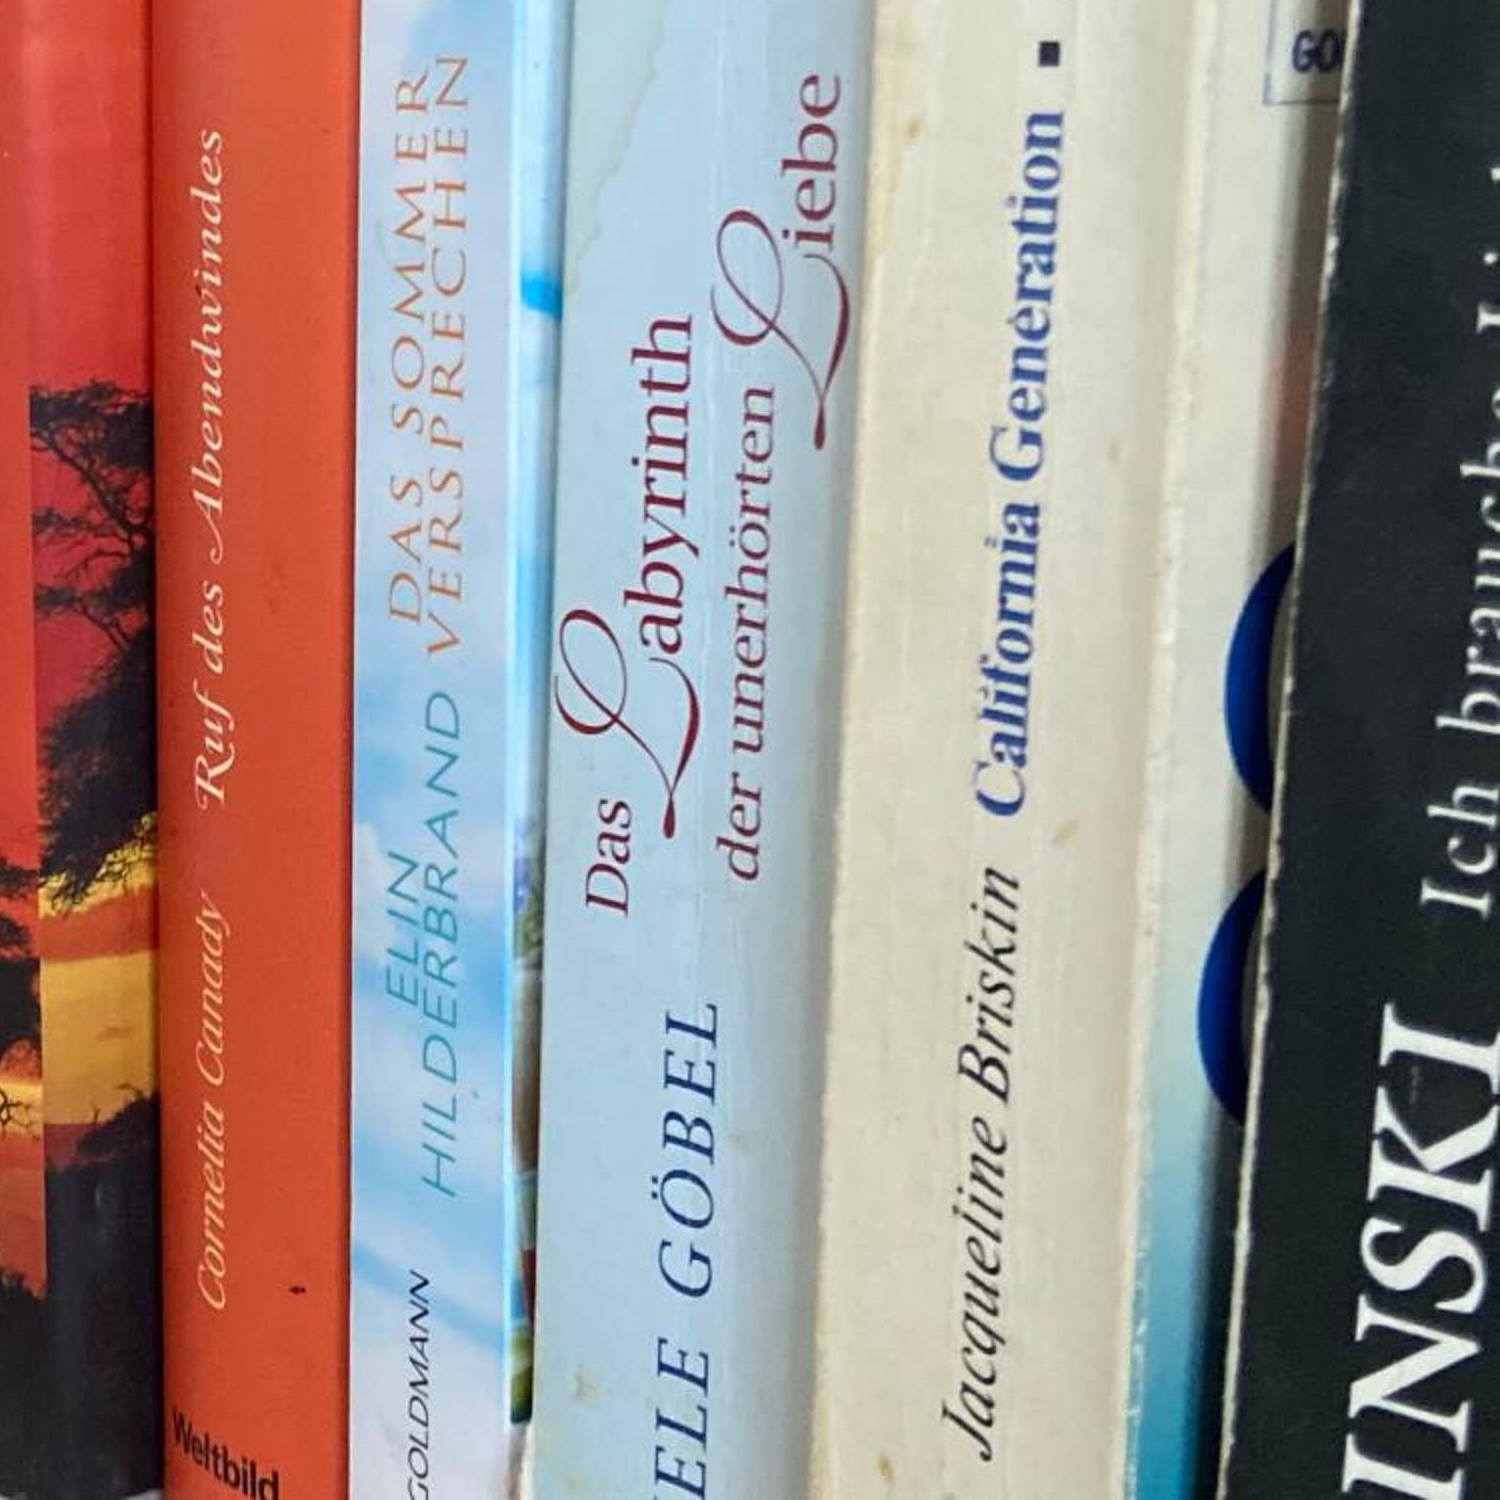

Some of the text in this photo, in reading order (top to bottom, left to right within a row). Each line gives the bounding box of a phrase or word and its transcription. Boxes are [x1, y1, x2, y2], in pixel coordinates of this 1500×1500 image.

[181, 128, 236, 812] Ruf des Abendwindes
[388, 67, 429, 625] DAS SOMMER
[426, 58, 469, 655] VERSPRECHEN
[711, 72, 850, 882] der unerhörten Liebe
[973, 109, 1065, 817] California Generation
[554, 314, 701, 918] Das Labyrinth
[1419, 783, 1500, 921] Ich
[195, 888, 231, 1312] Cornelia Canady
[385, 849, 419, 1008] ELIN
[420, 690, 461, 1198] HILDERBRAND
[651, 1001, 718, 1299] GÖBEL
[941, 865, 1021, 1463] Jacqueline Briskin
[171, 1403, 280, 1500] Weltbild
[406, 1268, 431, 1500] GOLDMANN
